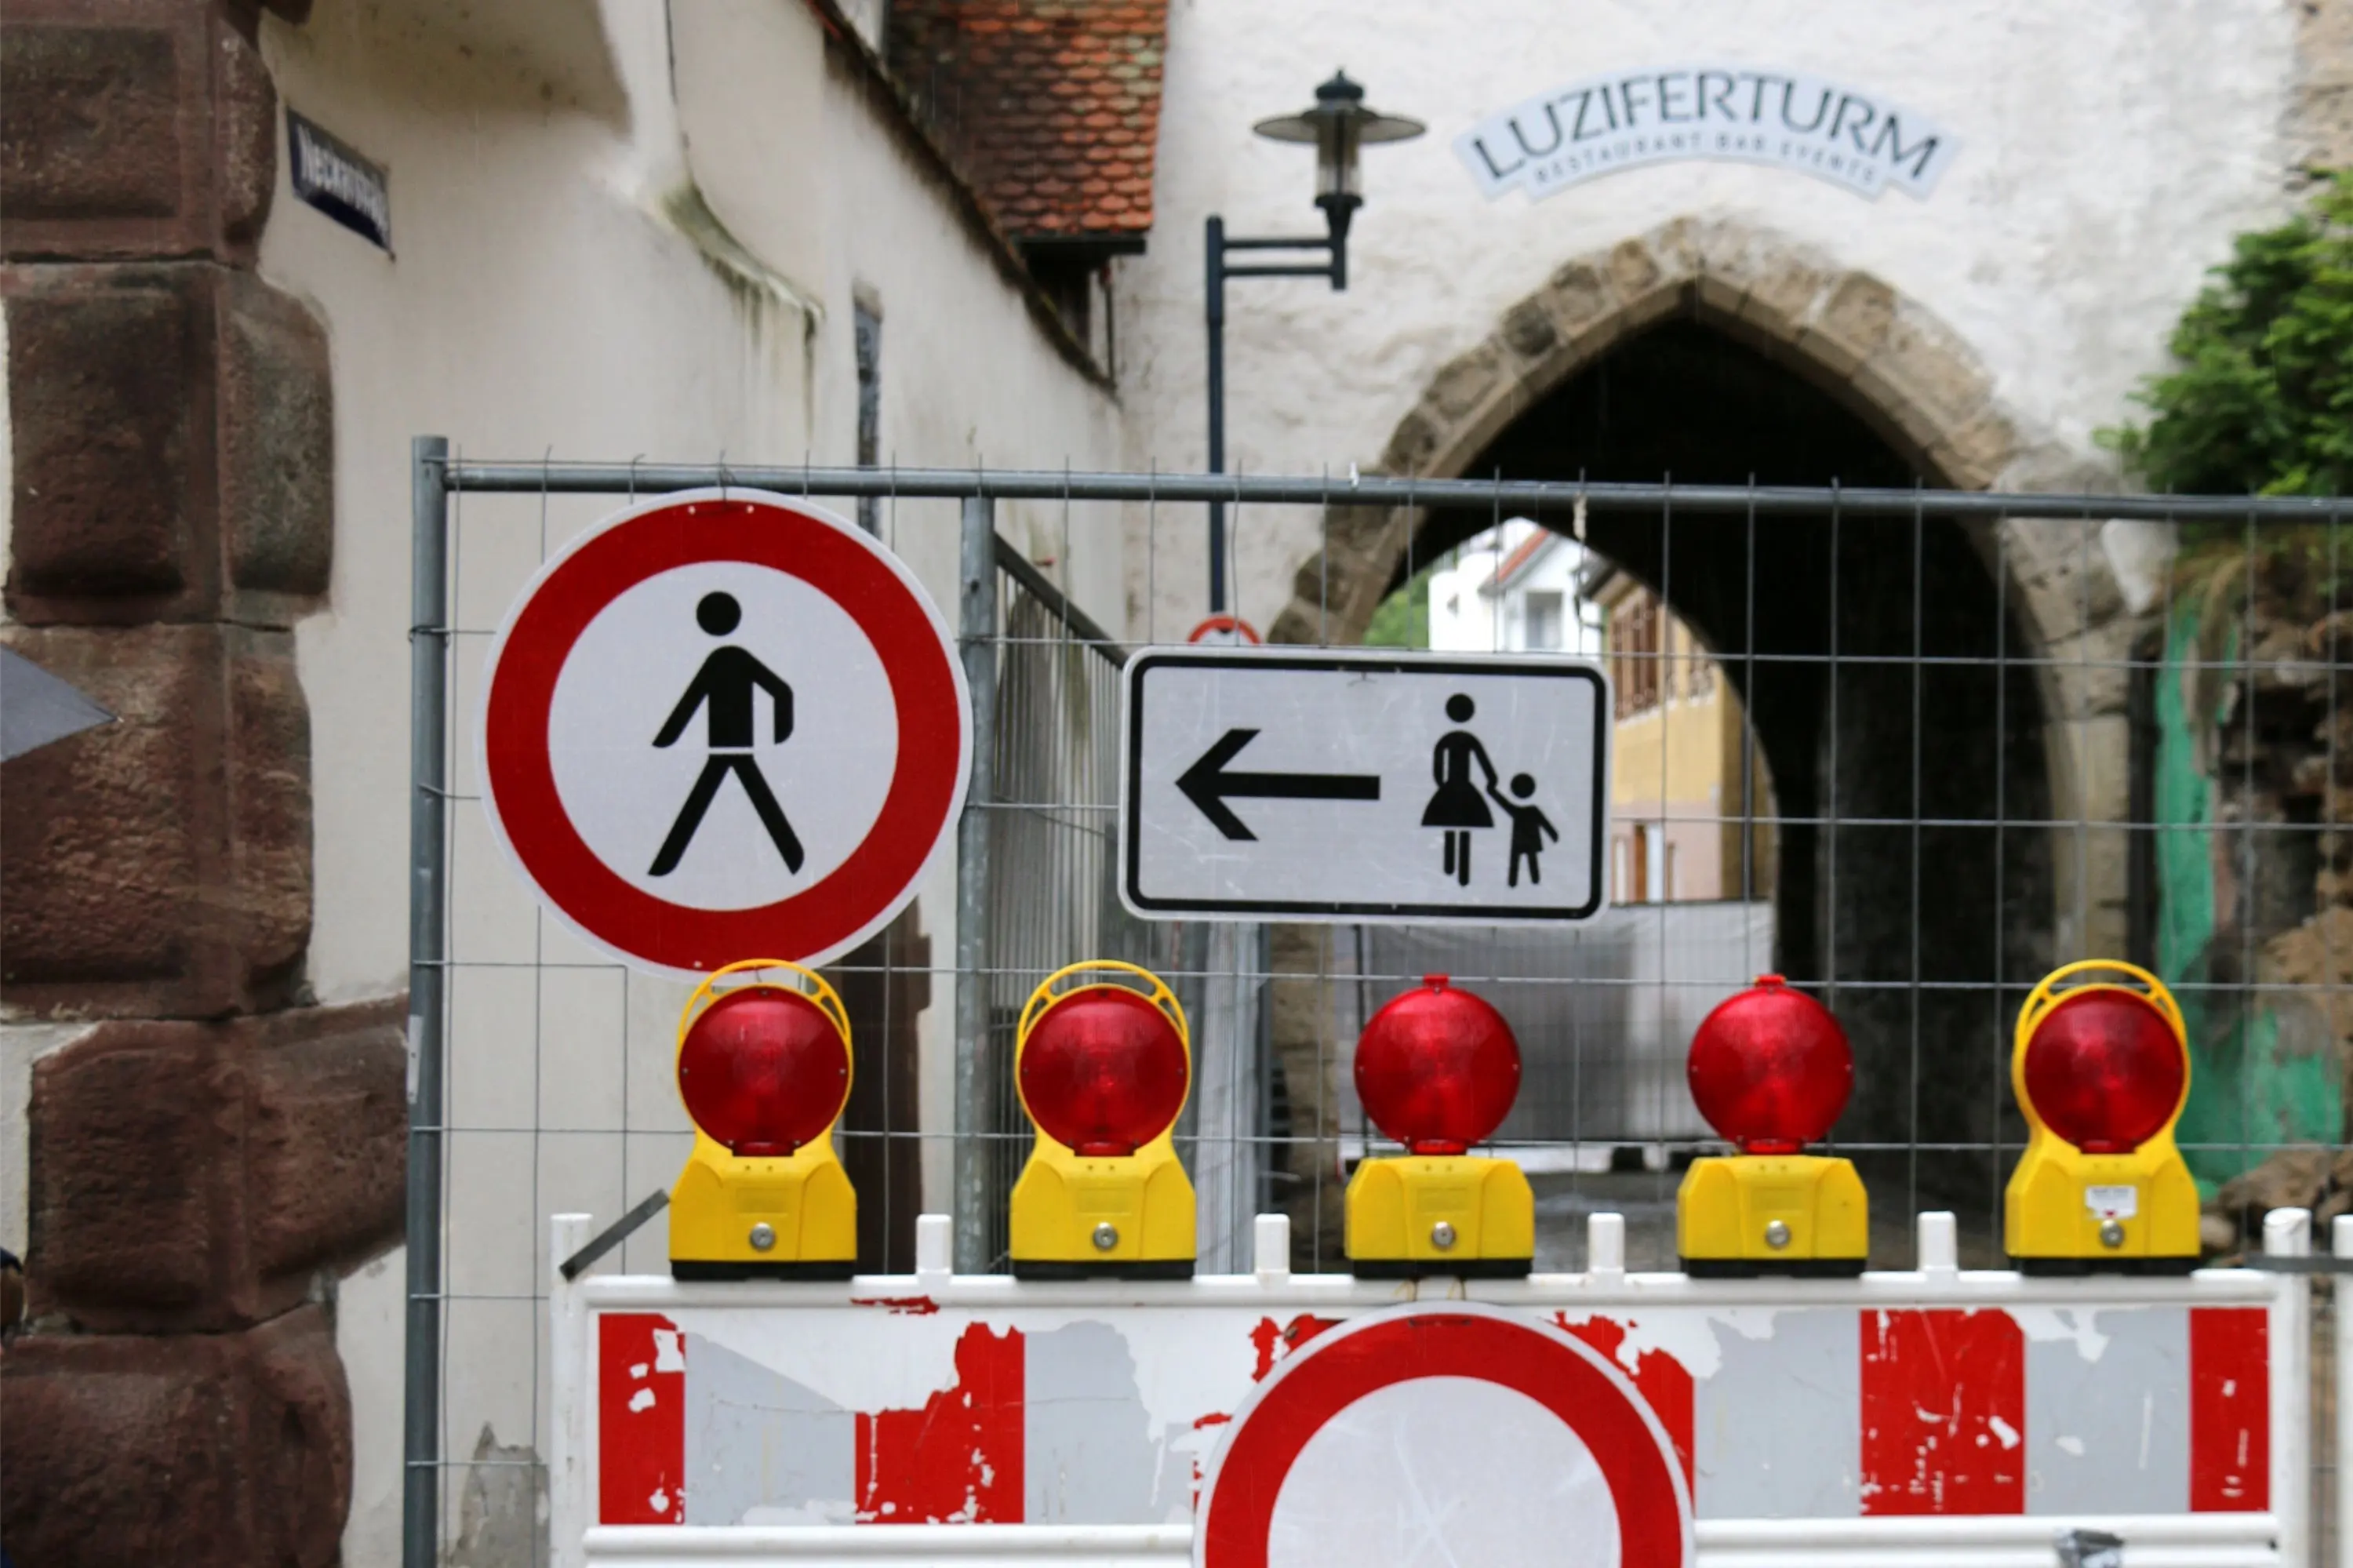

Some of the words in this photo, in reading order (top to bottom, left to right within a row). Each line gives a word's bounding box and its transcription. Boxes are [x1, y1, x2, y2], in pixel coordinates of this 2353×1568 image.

[1472, 71, 1940, 180] LUZIFERTURM
[1534, 132, 1703, 184] RESTAURANT
[1780, 140, 1876, 184] EVENTS
